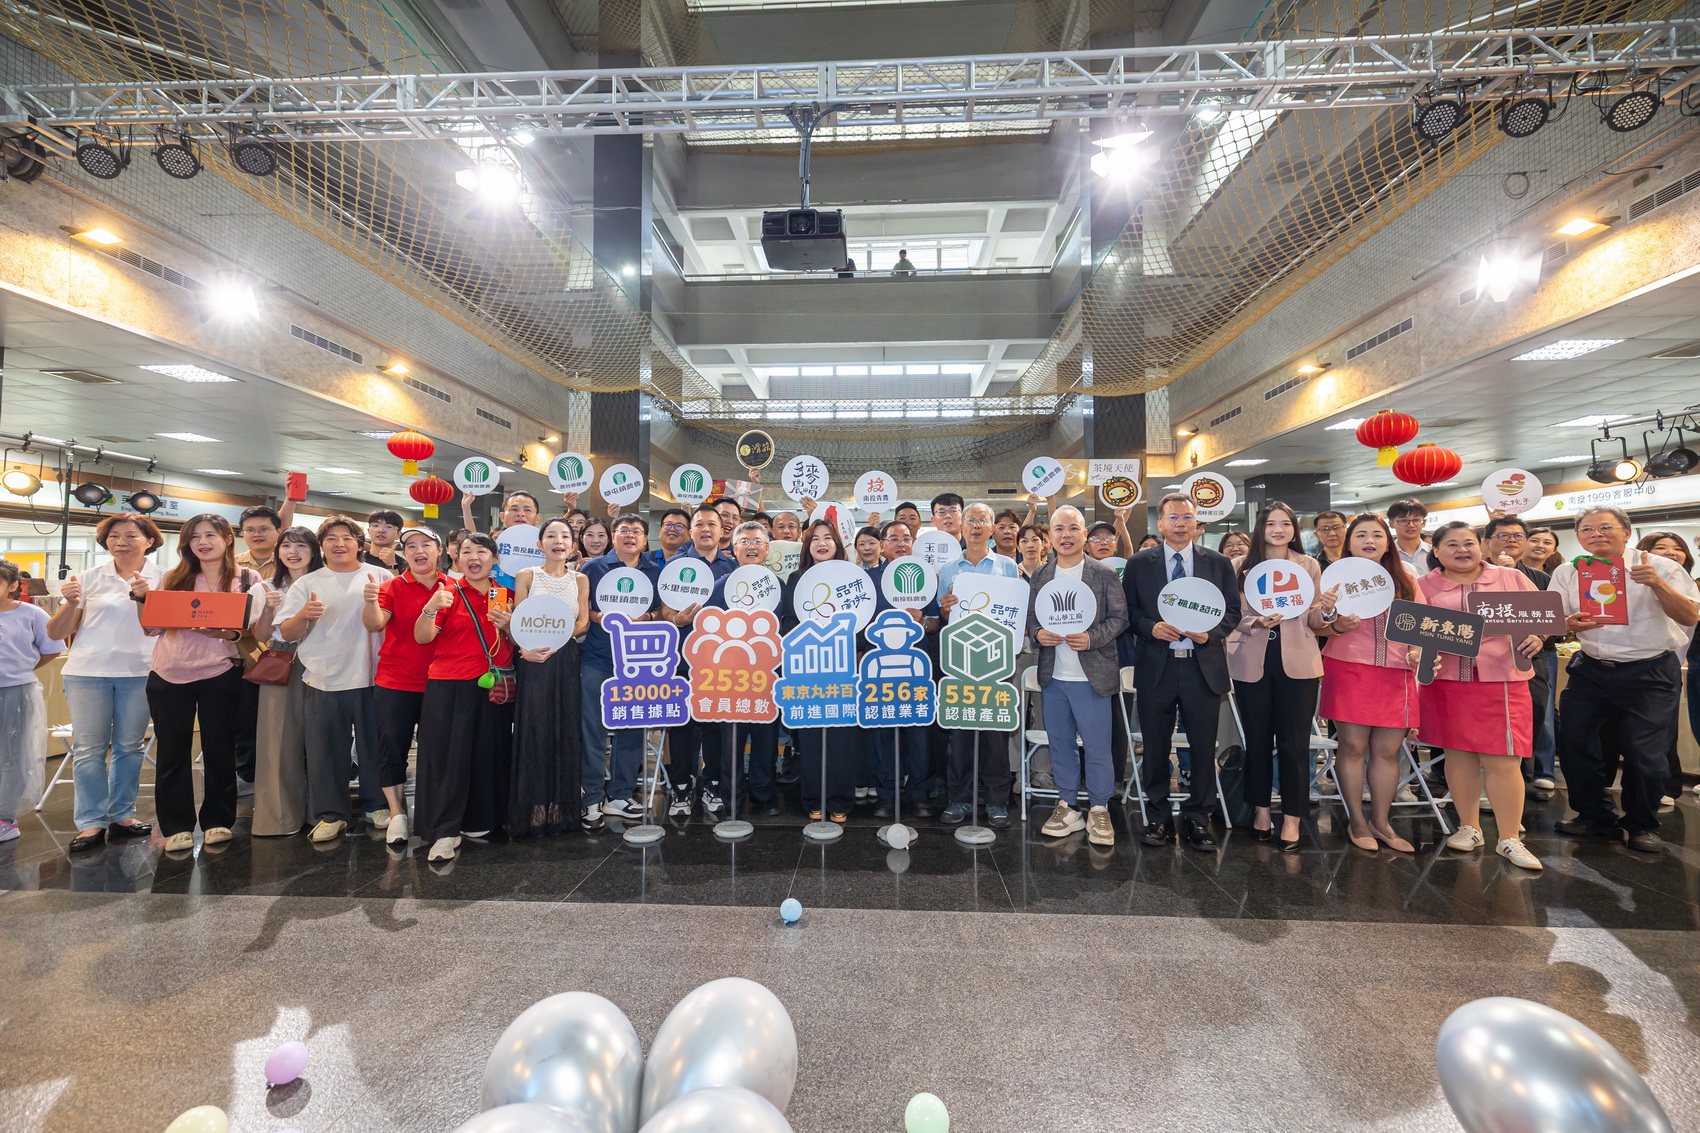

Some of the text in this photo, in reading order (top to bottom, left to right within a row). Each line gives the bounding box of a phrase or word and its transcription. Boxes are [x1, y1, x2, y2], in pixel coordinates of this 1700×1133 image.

[1094, 463, 1135, 473] 茶境天使
[603, 480, 642, 497] 草屯鎮農會
[1568, 485, 1656, 505] 南投1999客服中心
[863, 494, 889, 502] 南投青農
[512, 545, 546, 557] 南投縣政
[659, 582, 710, 596] 水里鄉農會
[751, 574, 771, 592] 品味
[835, 577, 864, 599] 品味
[1343, 574, 1388, 595] 新東陽
[1361, 589, 1376, 597] TUNG
[1376, 585, 1391, 594] YANG
[598, 594, 650, 605] 埔里鎮農會
[1177, 598, 1223, 617] 楓康超市
[1260, 594, 1304, 610] 萬家福
[990, 603, 1020, 620] 品味
[1420, 616, 1475, 640] 新東陽
[1419, 630, 1474, 646] HSIN TUNG YANG
[698, 668, 768, 693] 2539
[609, 683, 684, 702] 13000+
[781, 683, 857, 701] 東京丸井百
[864, 681, 929, 703] 256家
[945, 685, 1012, 708] 557件
[611, 703, 681, 721] 銷售據點
[698, 697, 770, 715] 會員總數
[789, 703, 857, 720] 前進國際
[864, 703, 930, 720] 認證業者
[944, 706, 1012, 723] 認證產品
